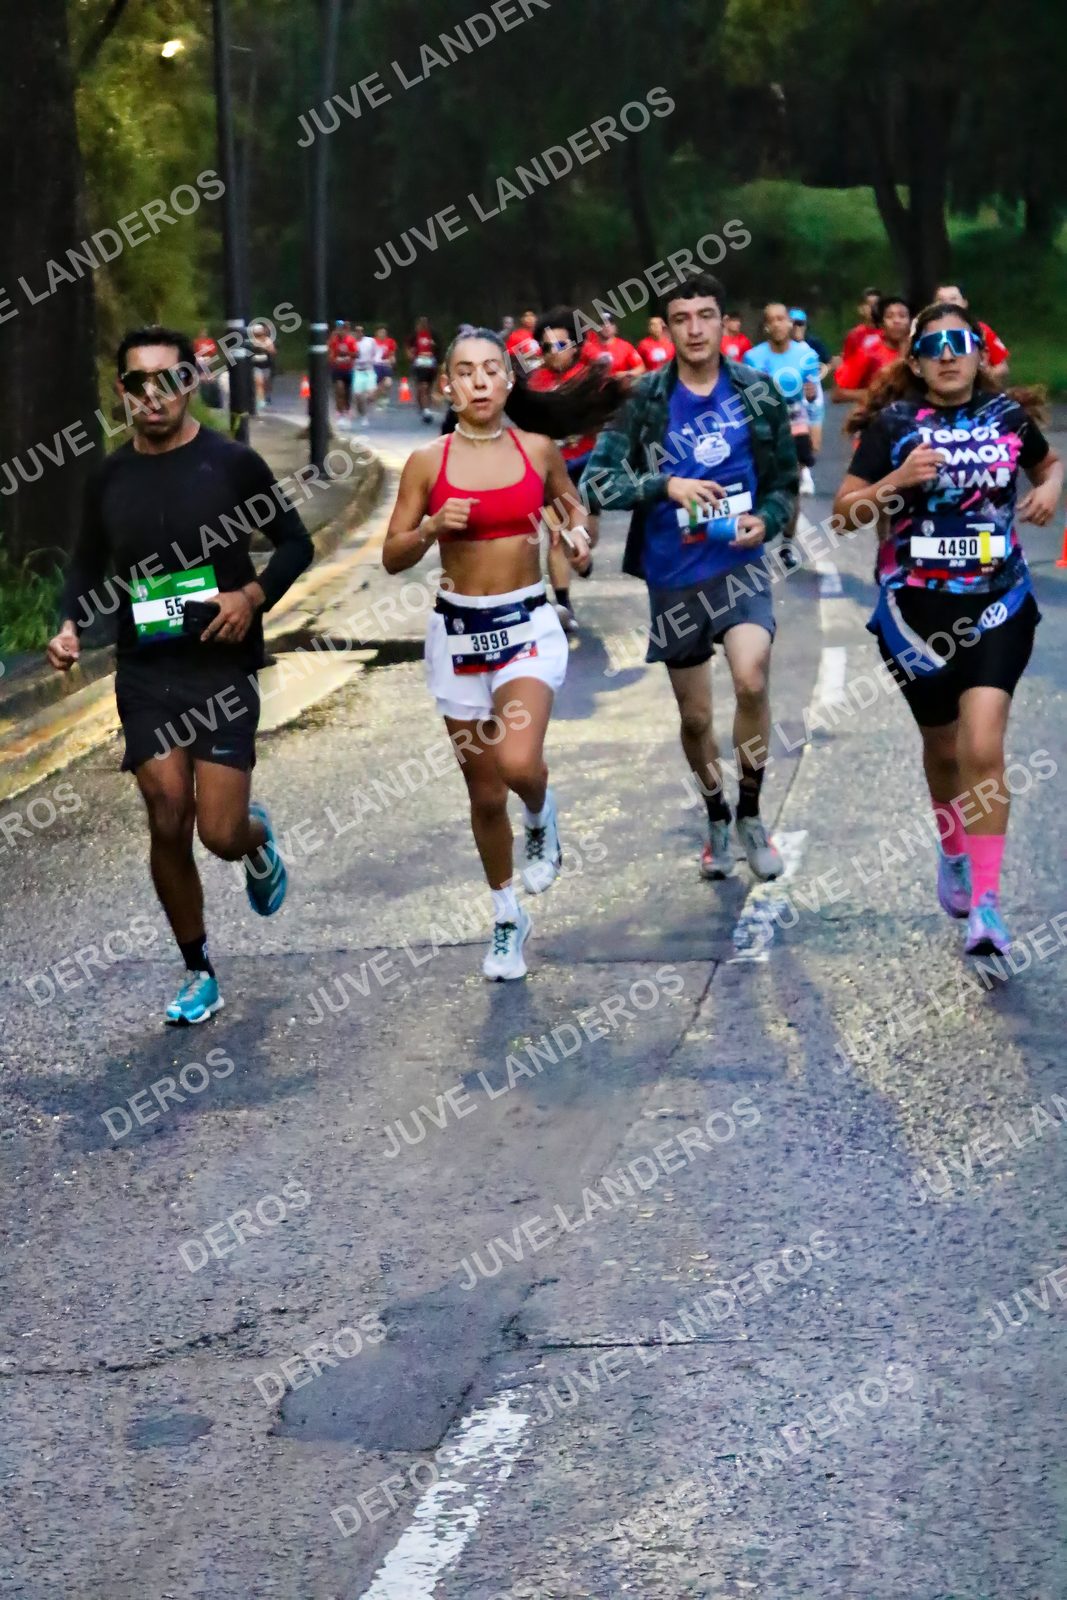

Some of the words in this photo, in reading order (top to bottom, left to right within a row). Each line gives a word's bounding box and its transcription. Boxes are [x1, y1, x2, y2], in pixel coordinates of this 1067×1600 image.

[918, 421, 1001, 444] TODOS
[933, 443, 1010, 466] OMOS
[937, 538, 979, 557] 4490
[471, 629, 510, 652] 3998
